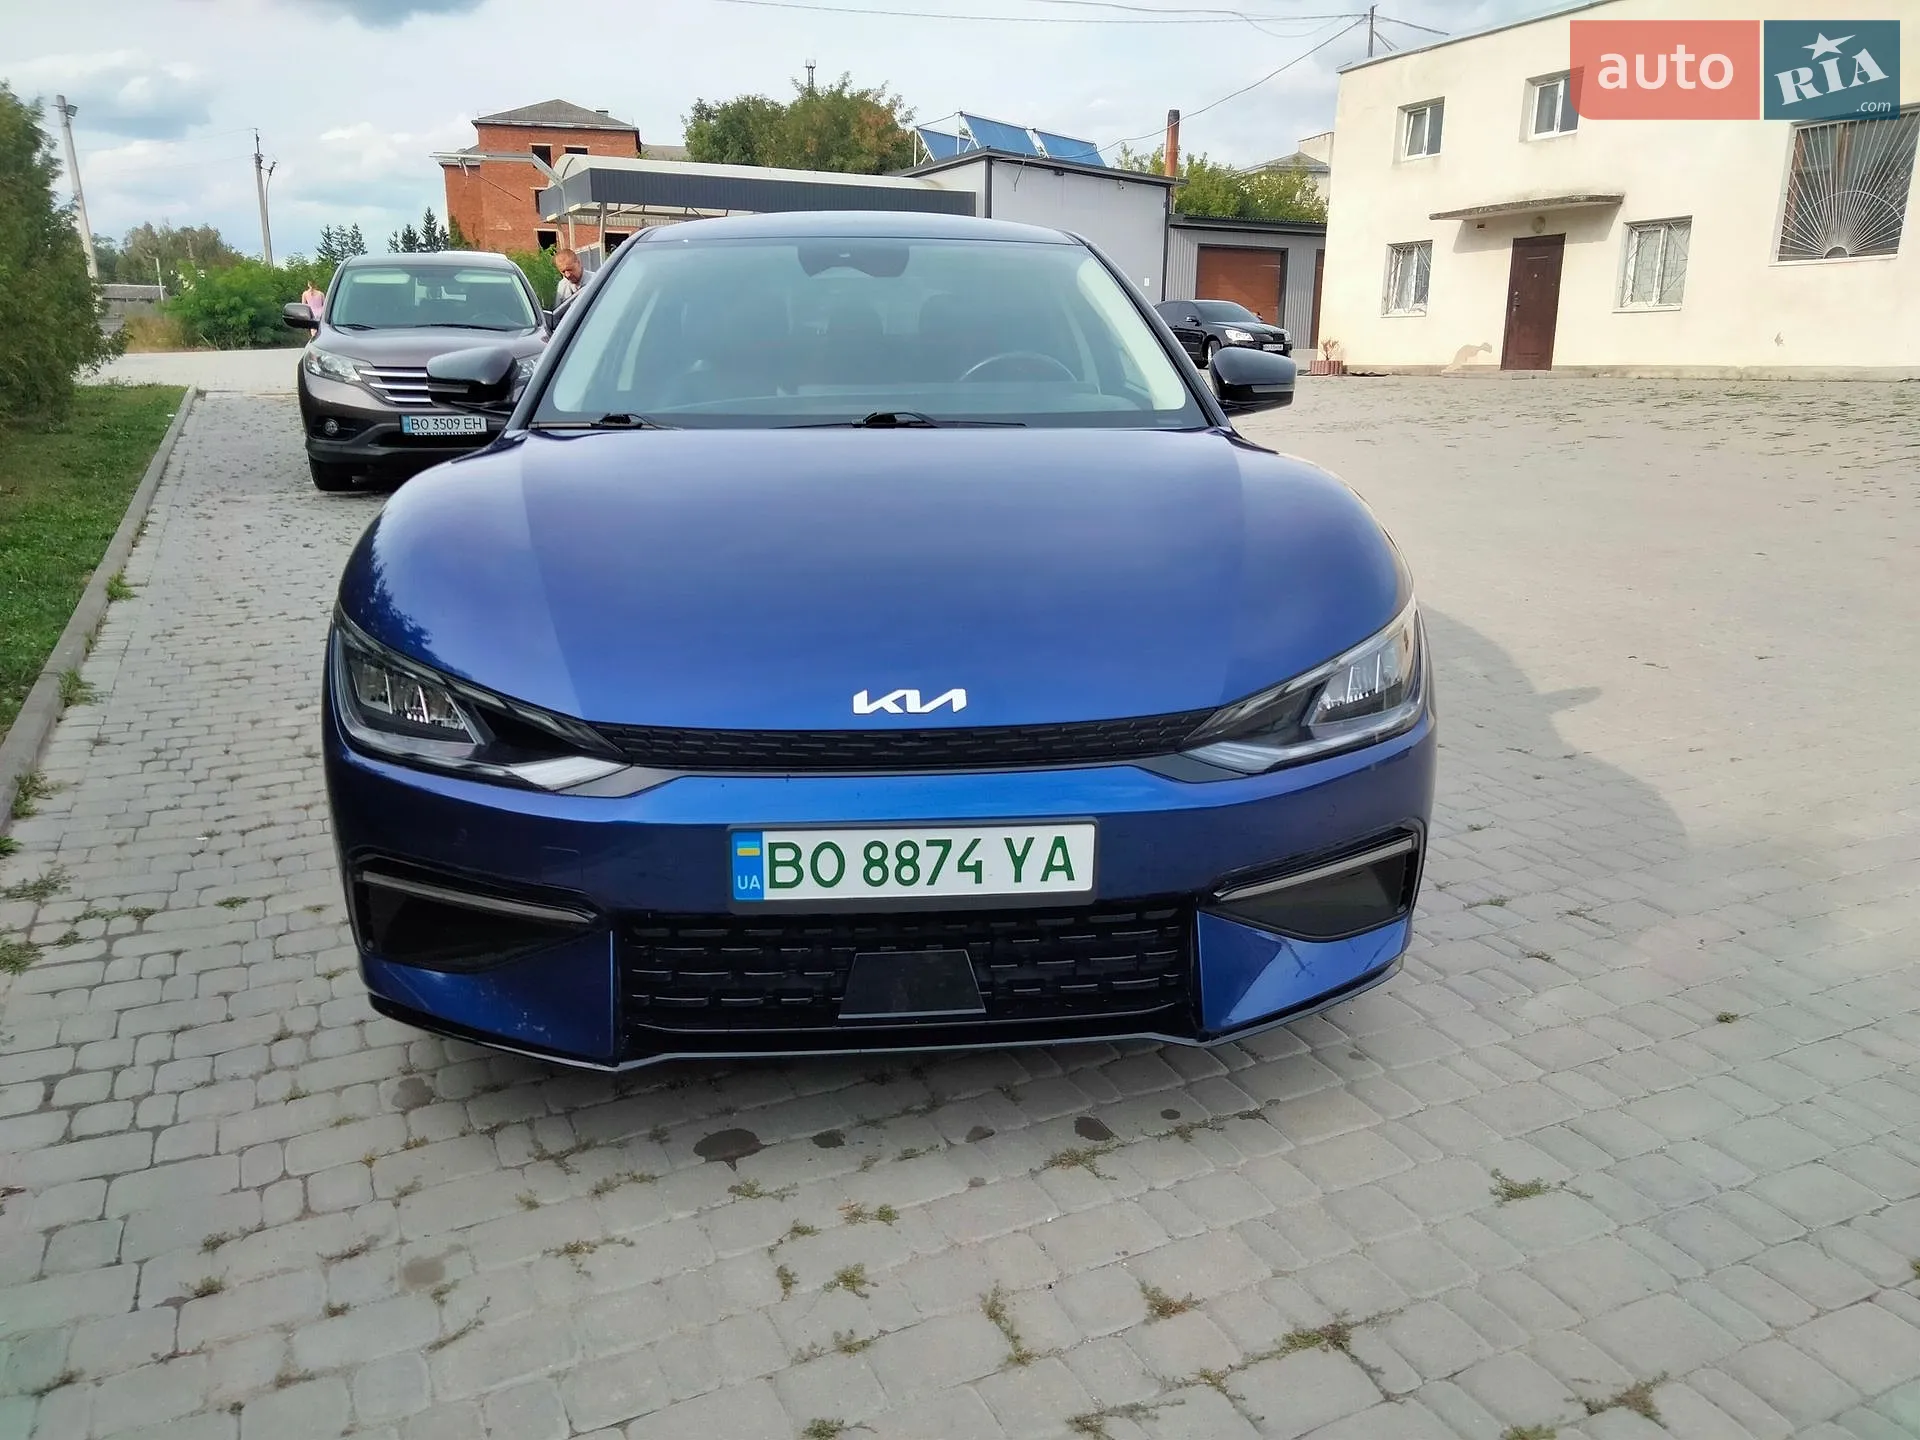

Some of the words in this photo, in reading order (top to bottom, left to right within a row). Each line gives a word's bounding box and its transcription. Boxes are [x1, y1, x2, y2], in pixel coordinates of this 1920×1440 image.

[410, 418, 430, 431] BO
[432, 418, 461, 431] 3509
[464, 417, 482, 430] EH
[768, 841, 846, 889] BO
[863, 839, 983, 888] 8874
[1004, 835, 1075, 883] YA
[737, 875, 761, 890] UA
